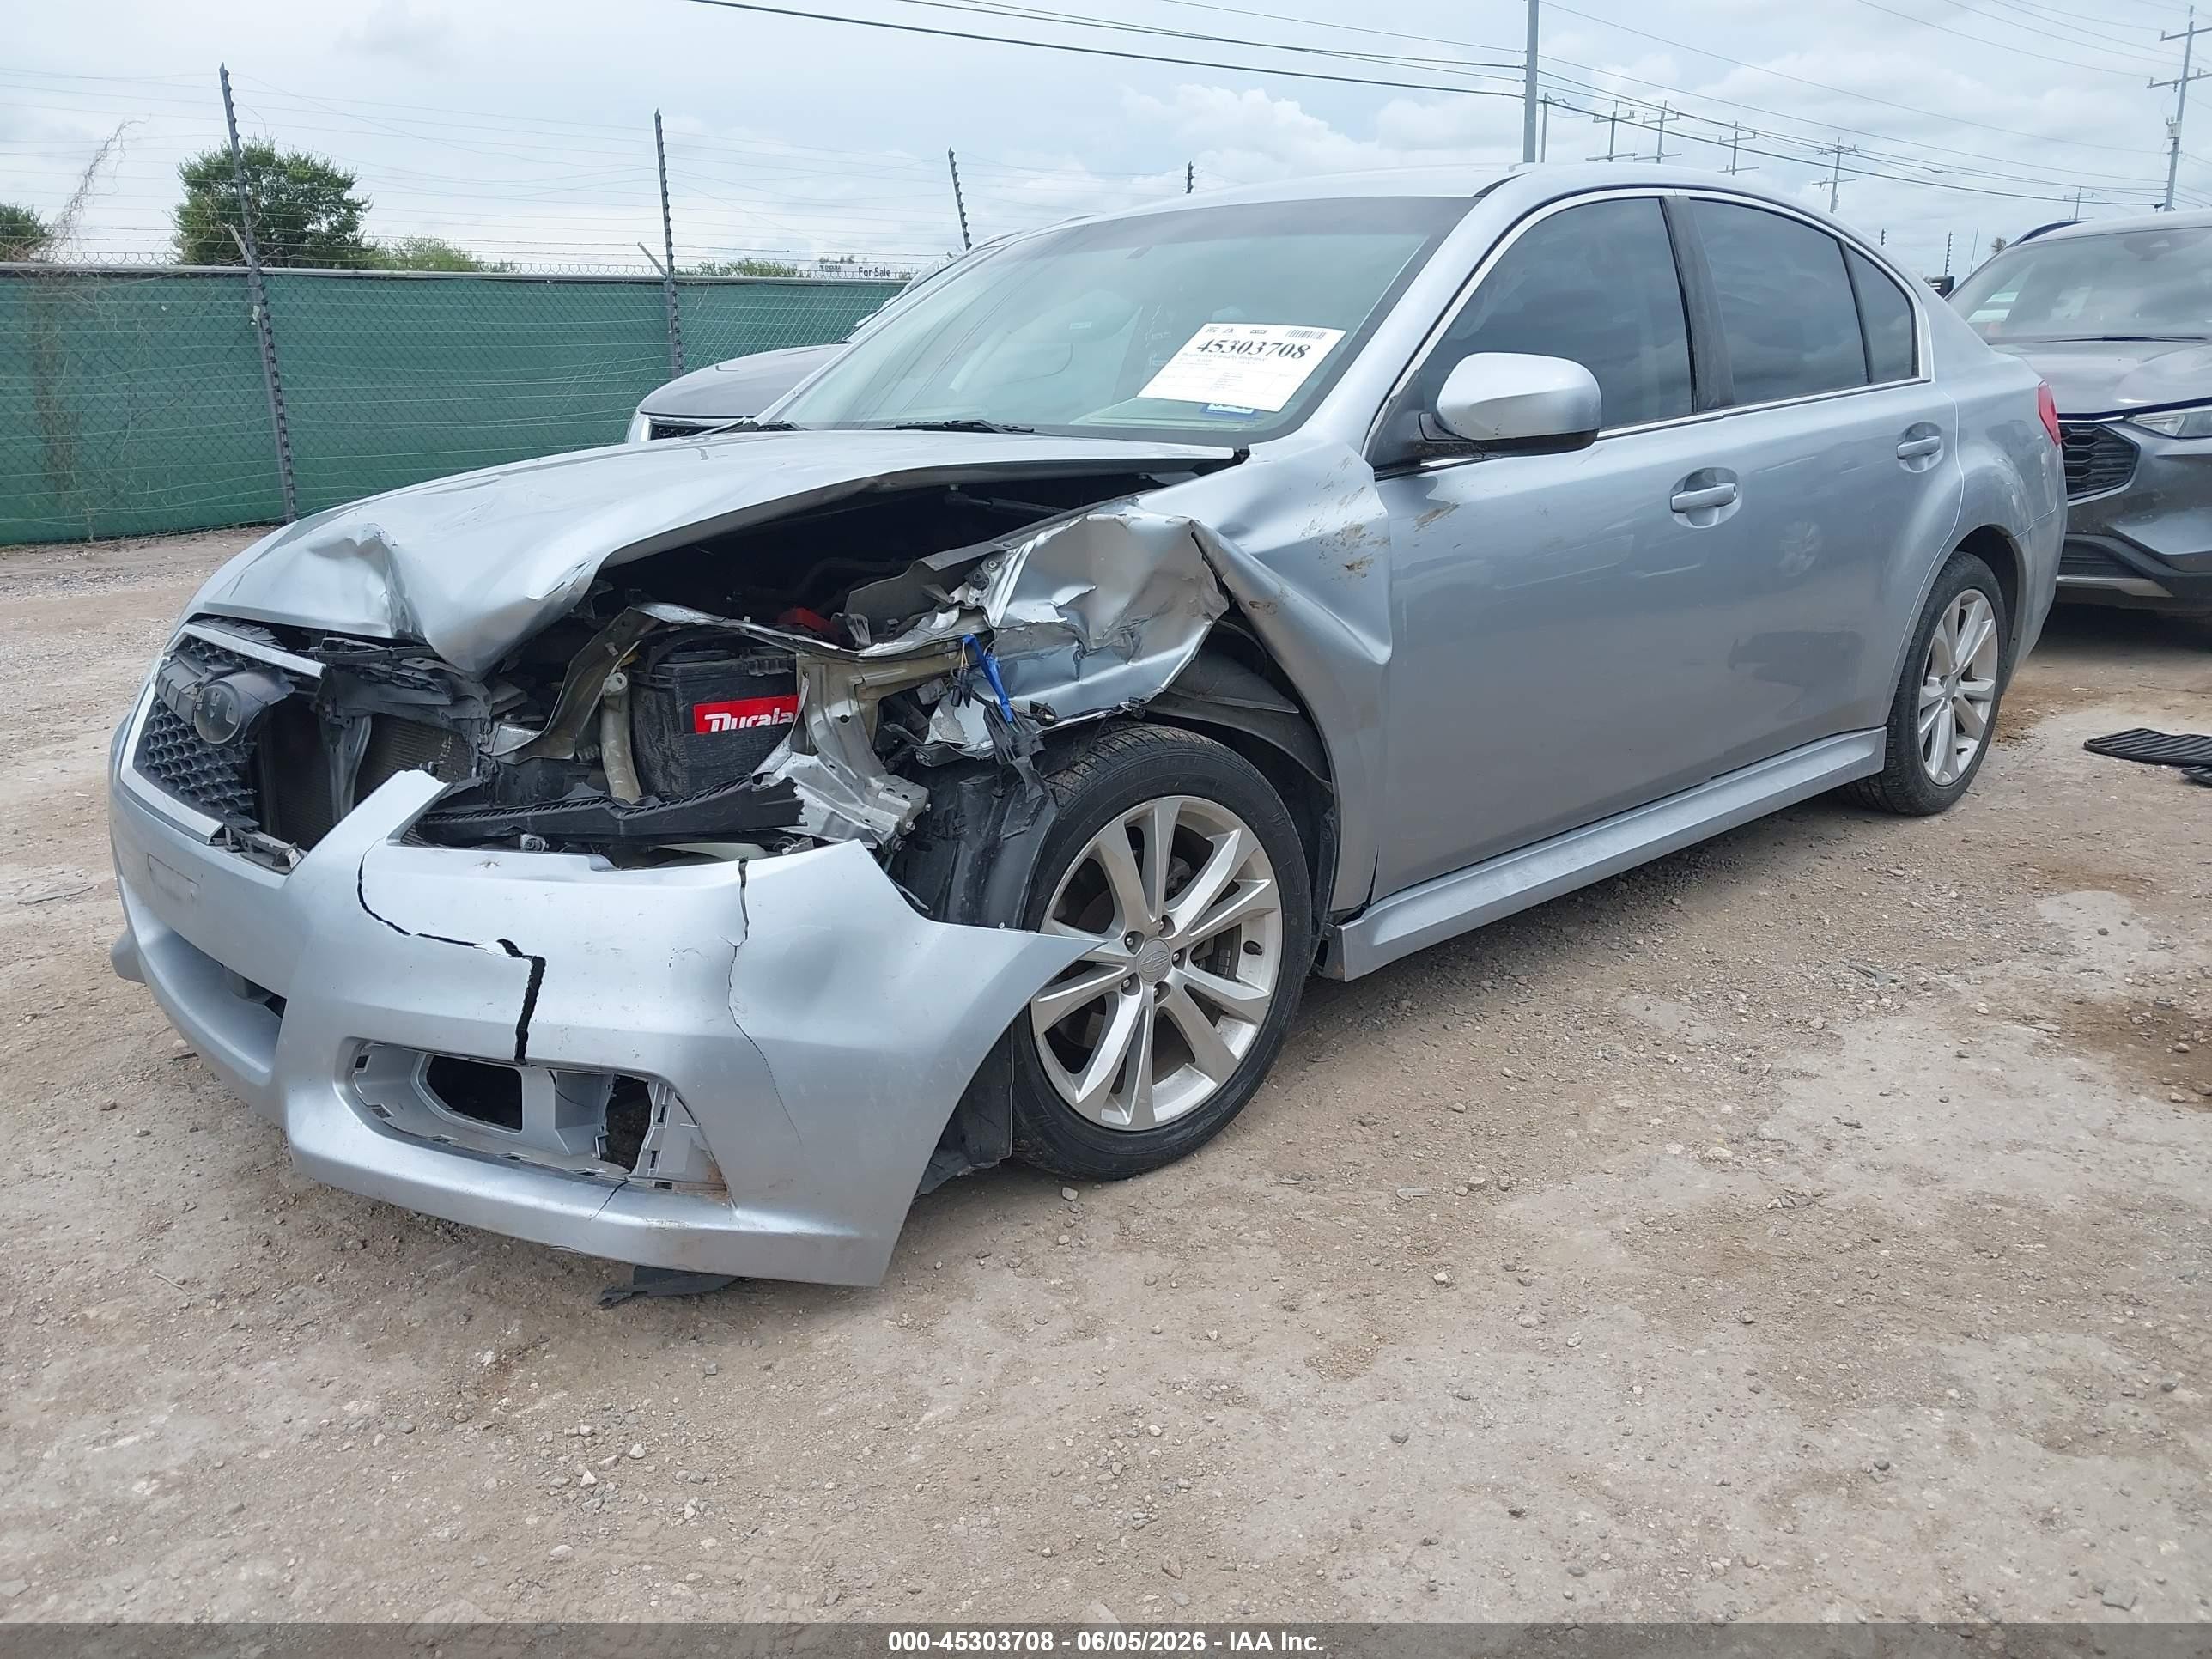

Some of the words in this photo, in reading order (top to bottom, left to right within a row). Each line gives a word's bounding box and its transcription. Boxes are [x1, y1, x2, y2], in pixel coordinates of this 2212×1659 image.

[859, 267, 872, 277] For
[874, 266, 890, 277] Sale
[1196, 338, 1311, 359] 45303708
